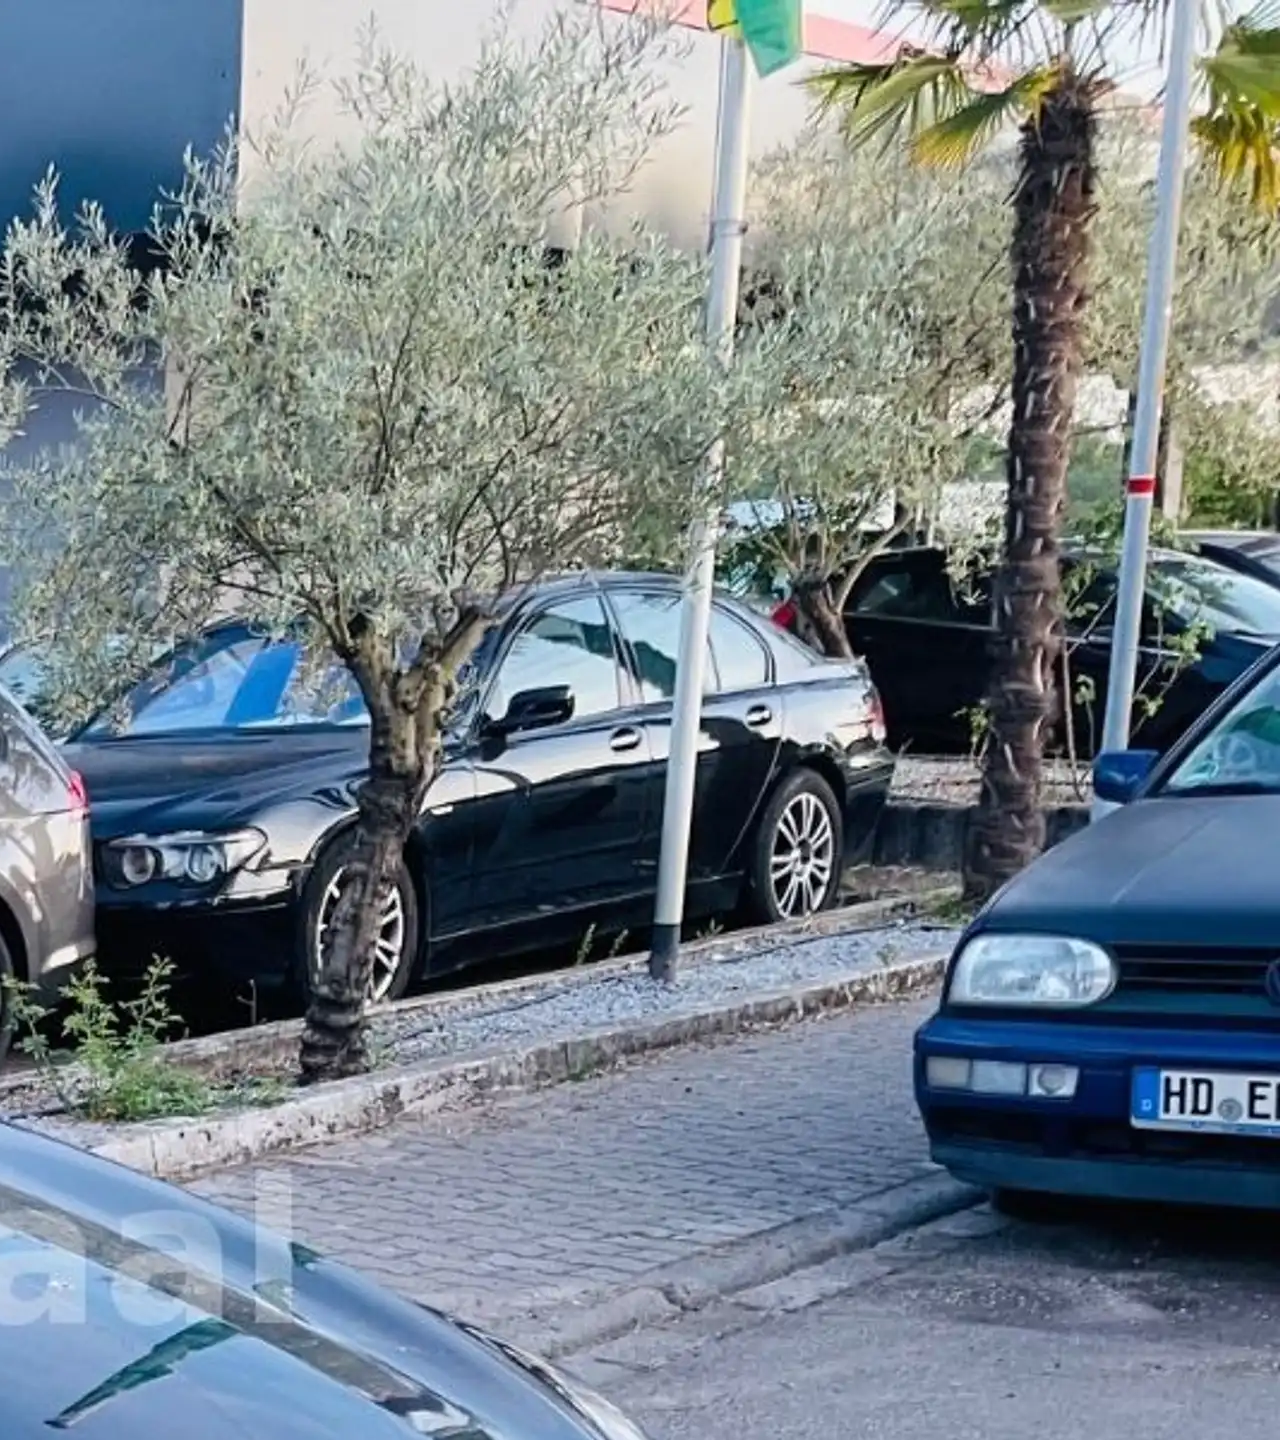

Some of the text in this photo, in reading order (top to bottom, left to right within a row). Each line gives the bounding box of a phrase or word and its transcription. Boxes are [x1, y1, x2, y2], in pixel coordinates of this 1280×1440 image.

[1141, 1098, 1152, 1112] D
[1163, 1075, 1280, 1120] HD E
